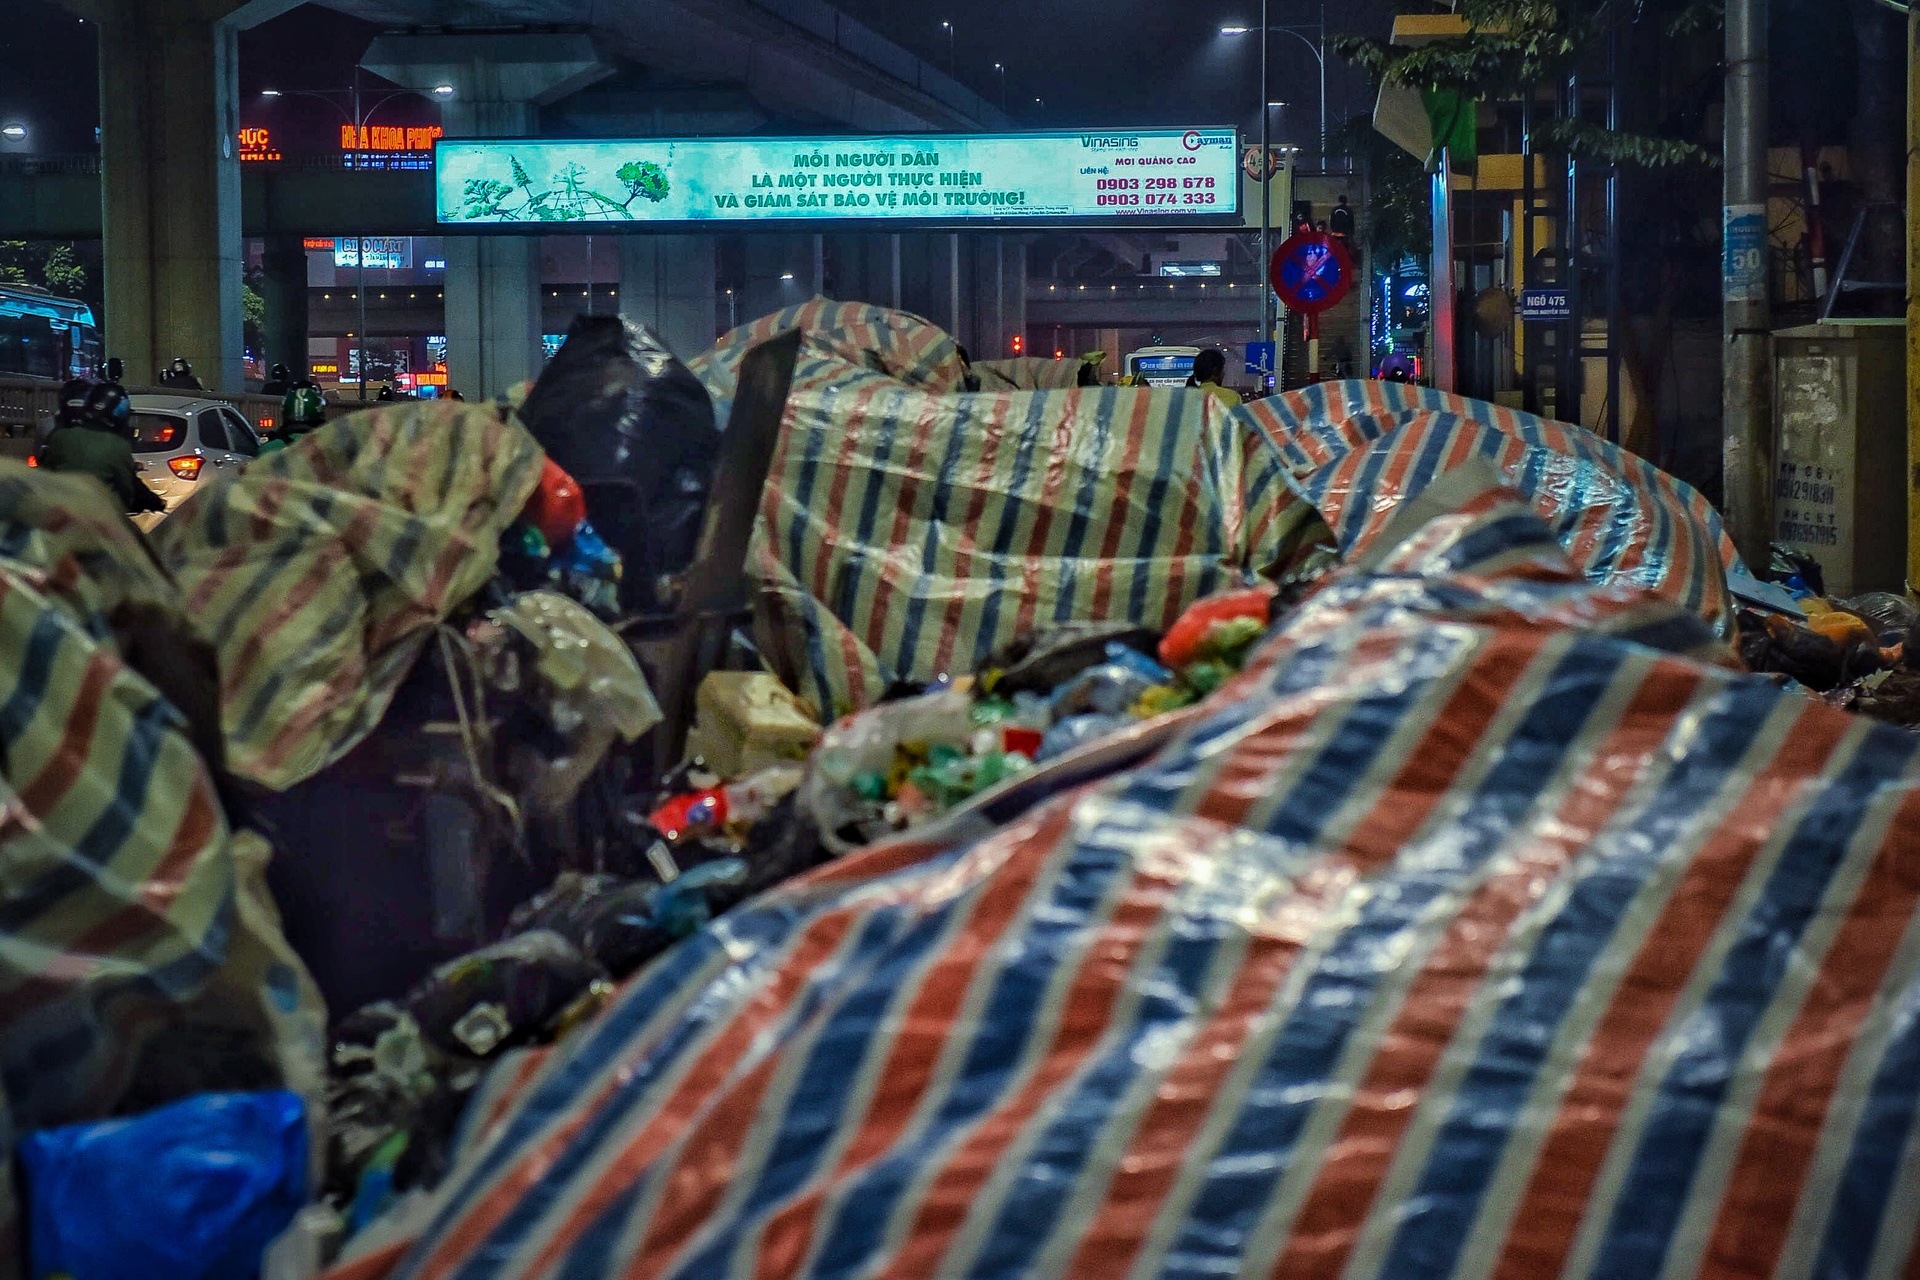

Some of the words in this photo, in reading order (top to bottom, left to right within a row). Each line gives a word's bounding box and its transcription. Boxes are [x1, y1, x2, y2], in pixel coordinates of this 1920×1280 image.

[371, 126, 404, 150] KHOA
[793, 149, 829, 167] MỖI
[835, 150, 895, 167] NGƯỜI
[901, 150, 939, 166] DÂN
[752, 172, 773, 187] LÀ
[778, 172, 817, 190] MỘT
[823, 170, 882, 187] NGƯỜI
[888, 172, 934, 189] THỰC
[939, 170, 982, 189] HIỆN
[1096, 178, 1139, 190] 0903
[1145, 178, 1177, 189] 298
[1183, 177, 1215, 188] 678
[714, 193, 739, 208] VÀ
[744, 192, 791, 207] GIÁM
[797, 191, 828, 207] SÁT
[833, 190, 870, 207] BẢO
[876, 190, 897, 209] VỆ
[902, 190, 938, 206] MÔI
[944, 189, 1025, 206] TRƯỜNG!
[1096, 194, 1139, 206] 0903
[1145, 193, 1177, 205] 074
[1183, 192, 1215, 204] 333
[343, 238, 372, 252] BIO
[373, 238, 404, 252] MART
[1733, 248, 1760, 270] 50
[1548, 296, 1566, 306] 475
